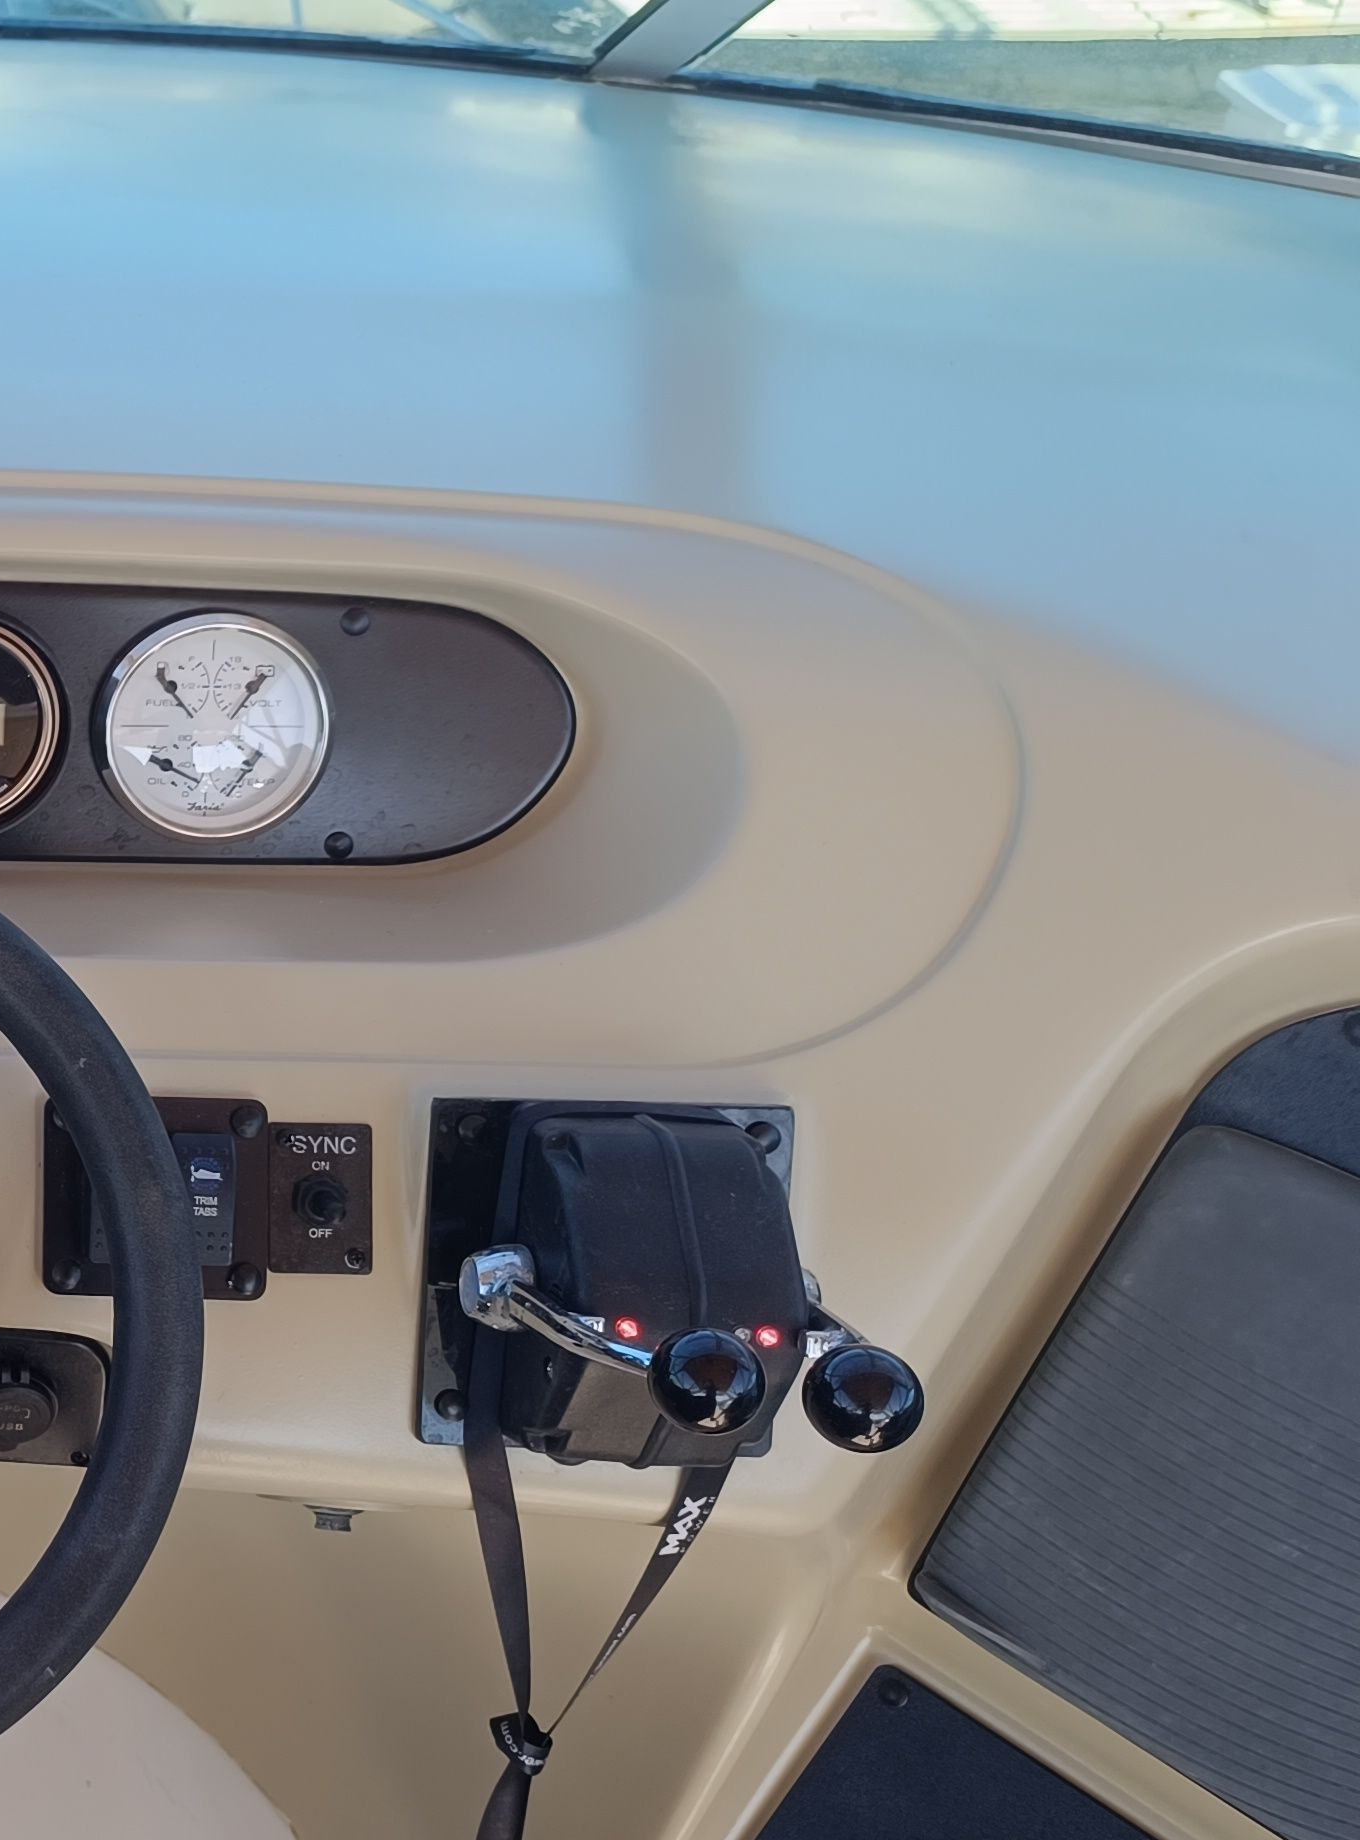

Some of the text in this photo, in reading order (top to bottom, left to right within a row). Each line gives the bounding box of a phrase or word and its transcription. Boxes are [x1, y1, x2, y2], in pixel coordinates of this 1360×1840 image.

[145, 699, 176, 707] FUEL
[248, 699, 282, 707] VOLT
[291, 1135, 357, 1155] SYNC
[311, 1160, 330, 1171] ON
[193, 1195, 218, 1207] TRIM
[192, 1206, 218, 1218] TABS
[308, 1227, 333, 1239] OFF
[658, 1496, 708, 1556] MAX
